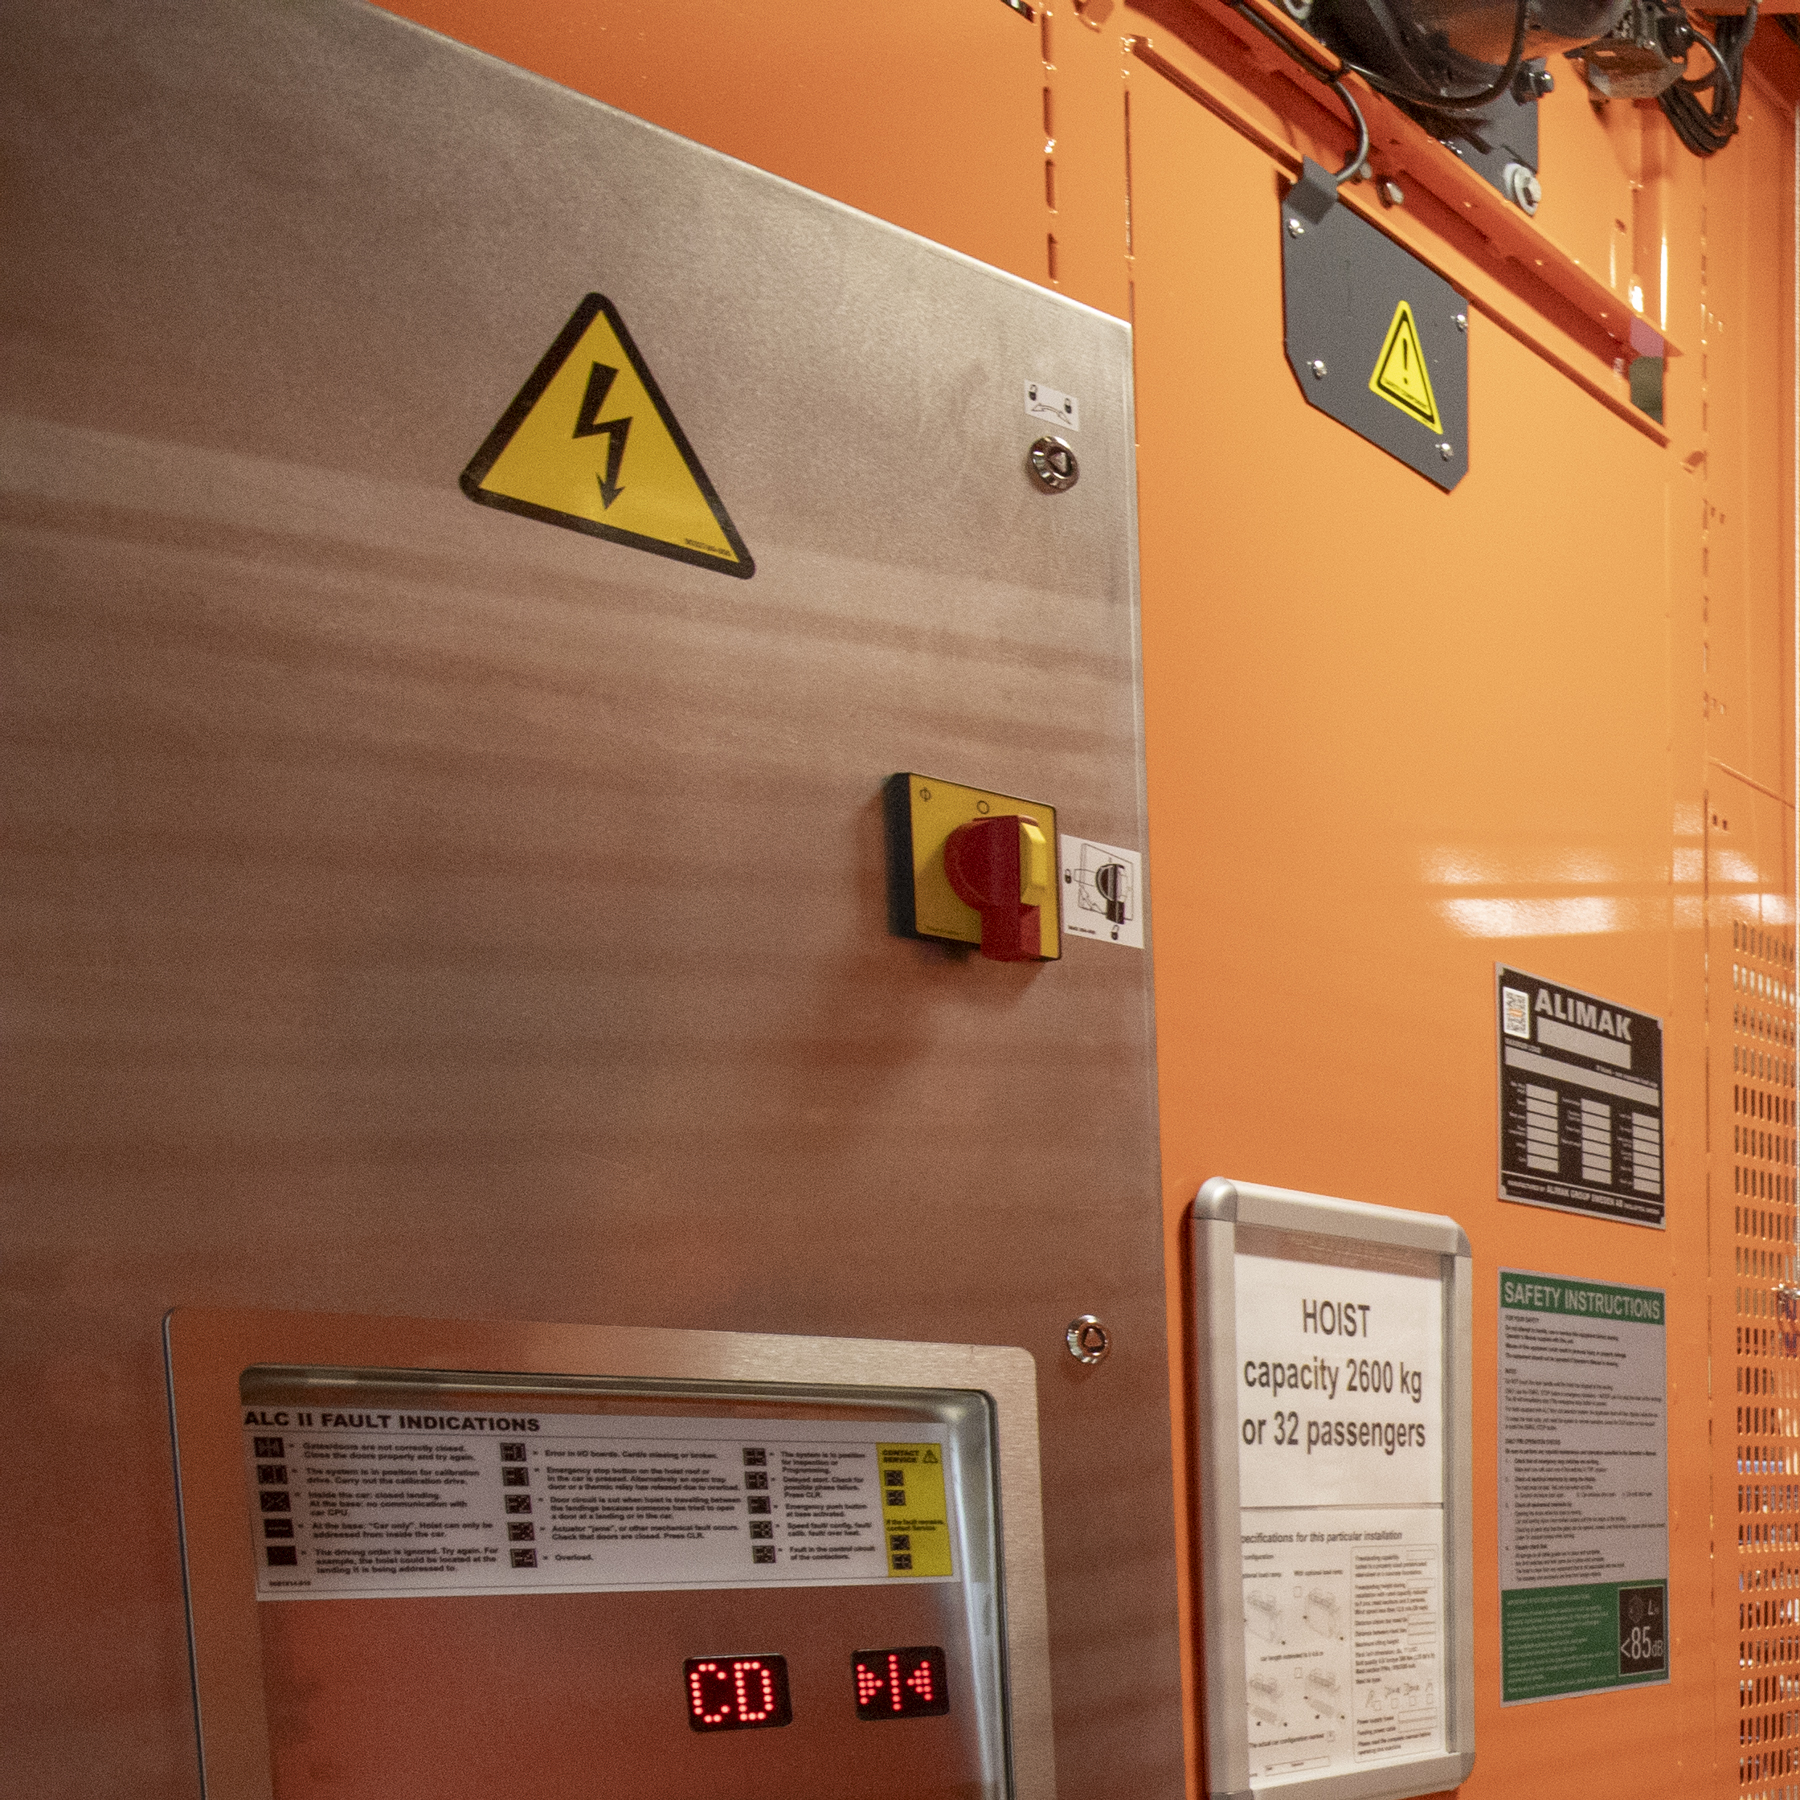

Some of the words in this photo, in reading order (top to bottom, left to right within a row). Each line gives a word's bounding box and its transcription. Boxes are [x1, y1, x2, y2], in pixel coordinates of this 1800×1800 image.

[1534, 988, 1632, 1041] ALIMAK
[1302, 1298, 1371, 1338] HOIST
[1504, 1281, 1561, 1309] SAFETY
[1564, 1289, 1660, 1319] INSTRUCTIONS
[1244, 1355, 1339, 1400] capacity
[1346, 1358, 1393, 1393] 2600
[1400, 1361, 1422, 1403] kg
[244, 1412, 289, 1426] ALC
[298, 1413, 313, 1427] II
[322, 1413, 392, 1429] FAULT
[400, 1416, 541, 1432] INDICATIONS
[1242, 1418, 1267, 1445] or
[1273, 1410, 1299, 1445] 32
[1307, 1420, 1426, 1455] passengers
[1296, 1531, 1308, 1542] for
[1310, 1531, 1325, 1542] this
[1326, 1531, 1362, 1544] particular
[1364, 1530, 1402, 1541] installation
[690, 1661, 773, 1722] CD
